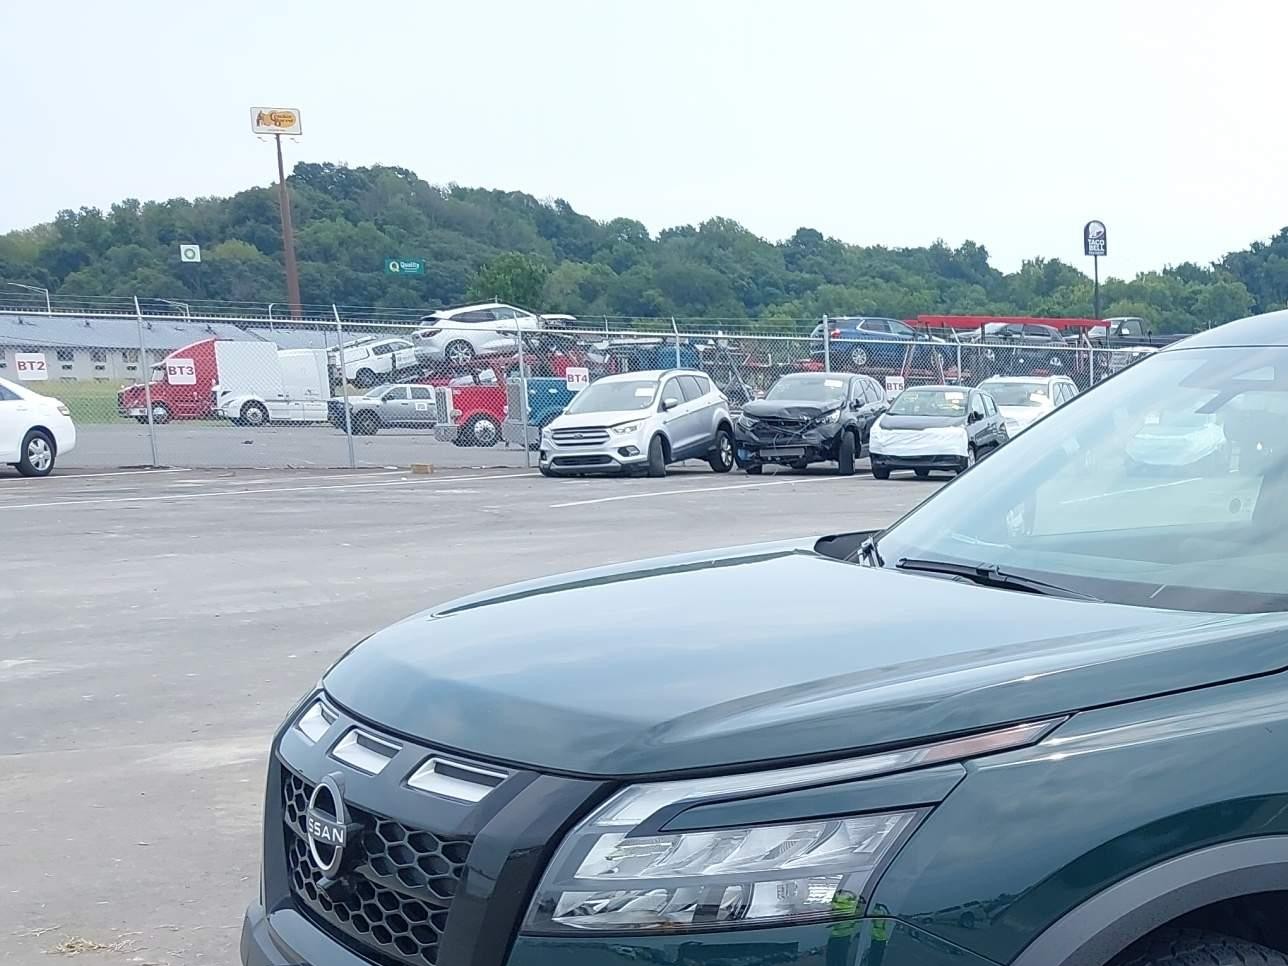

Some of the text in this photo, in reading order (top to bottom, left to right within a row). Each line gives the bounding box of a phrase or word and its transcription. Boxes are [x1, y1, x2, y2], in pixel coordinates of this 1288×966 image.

[17, 360, 46, 371] BT2
[168, 366, 194, 376] BT3
[567, 374, 588, 383] BT4
[308, 817, 344, 843] SSAN
